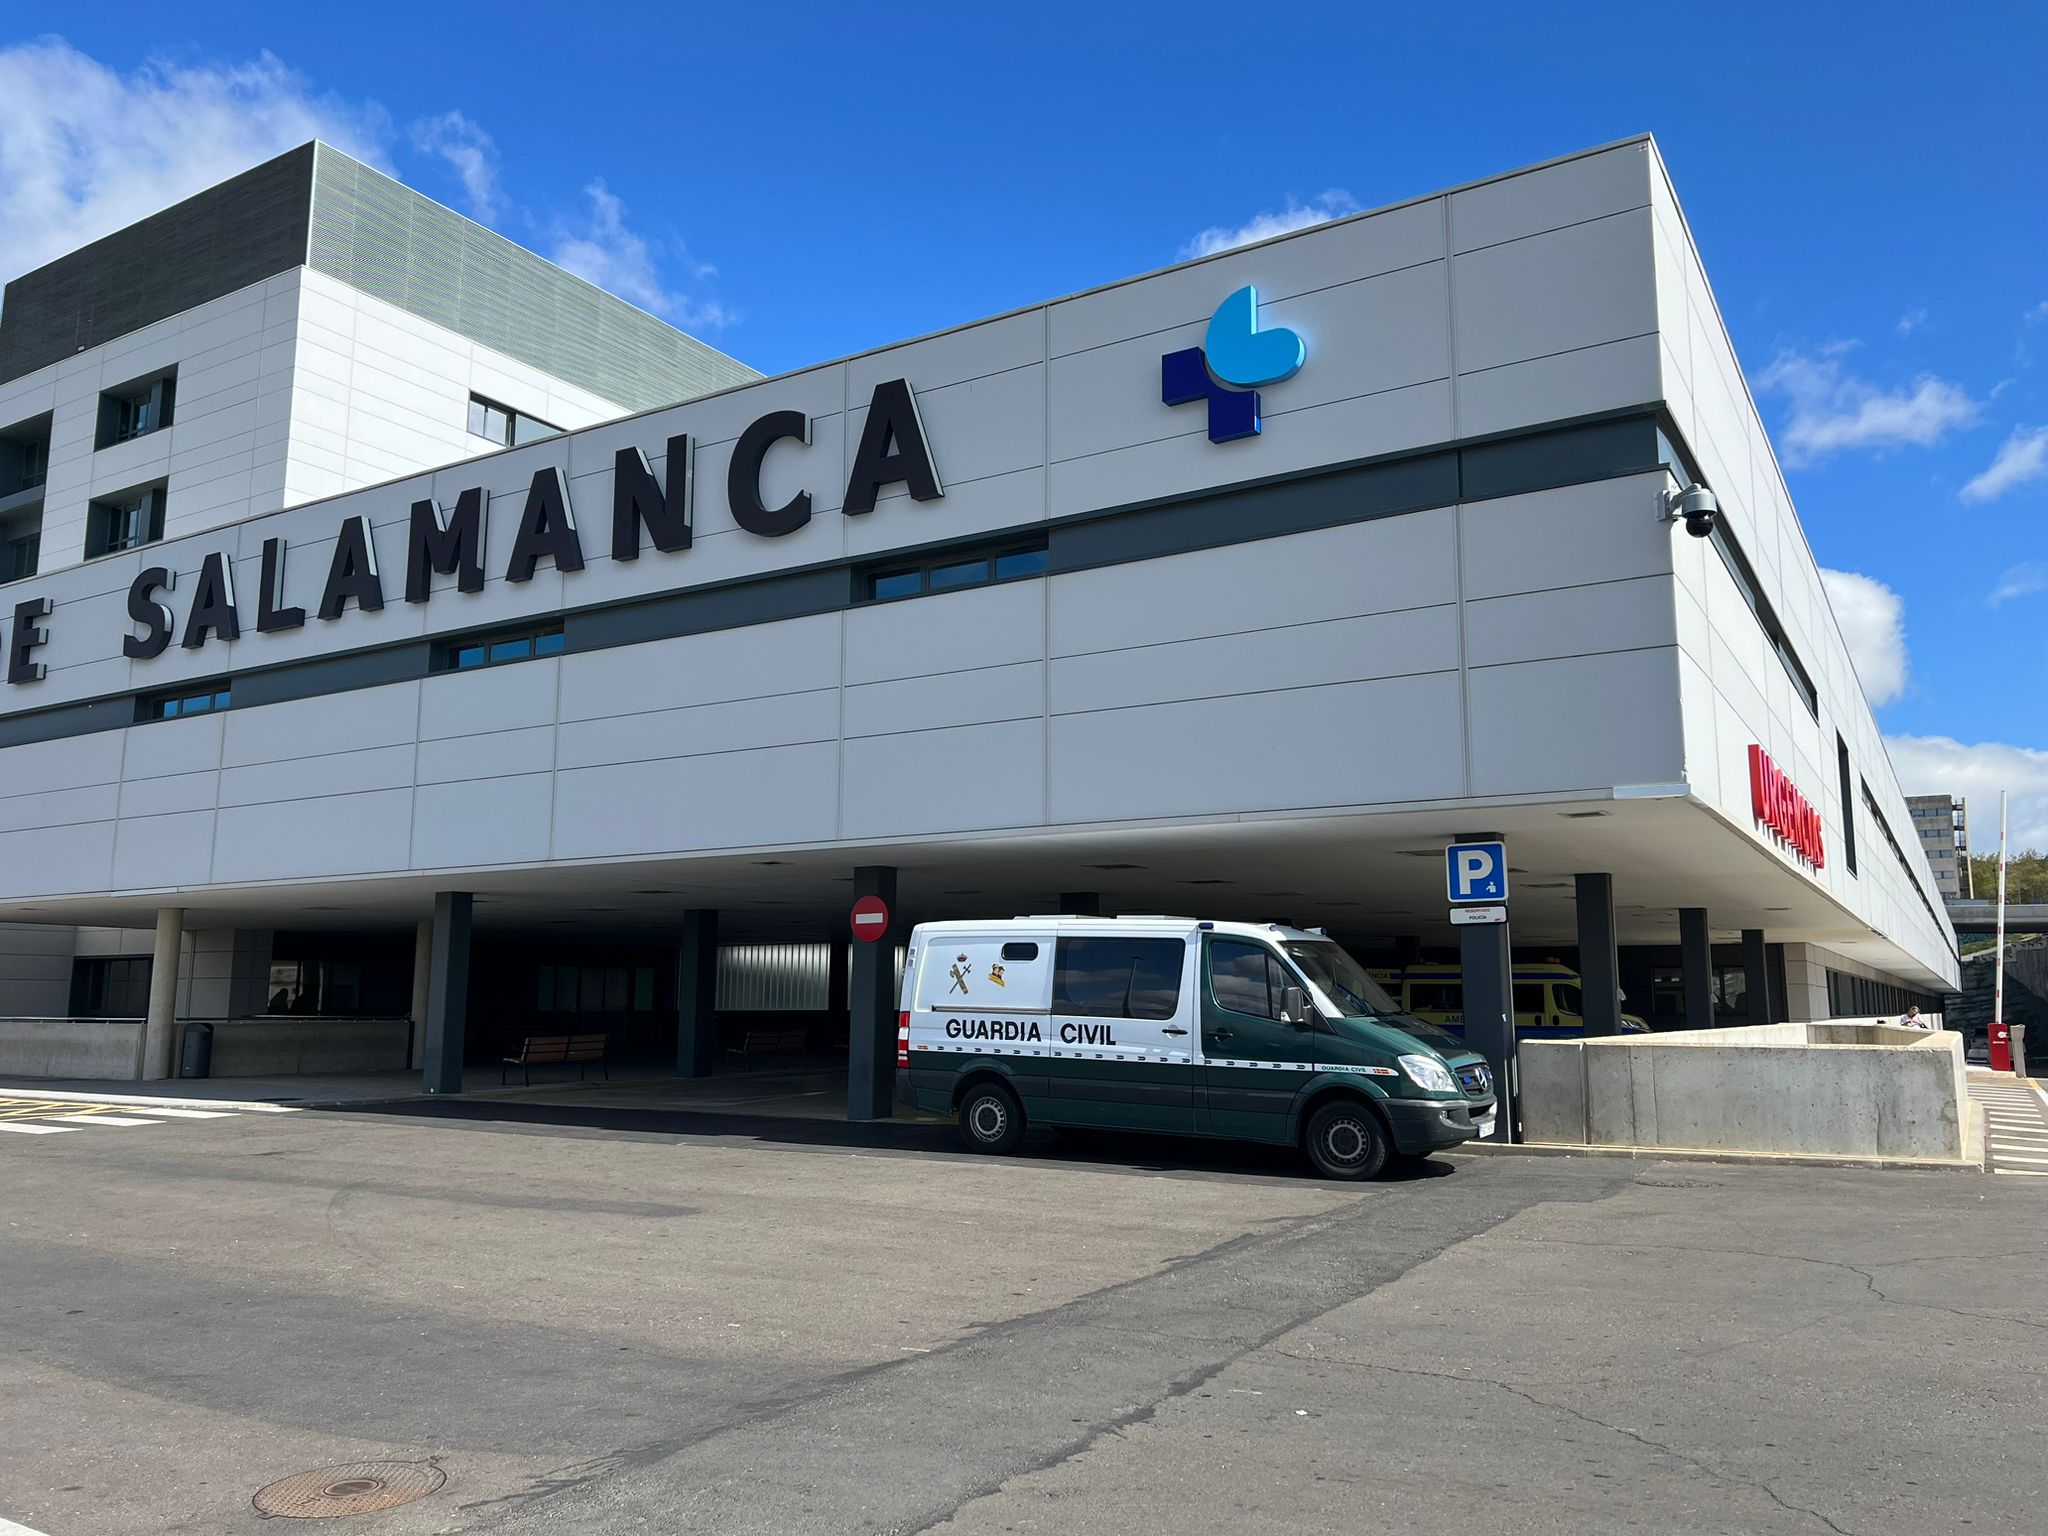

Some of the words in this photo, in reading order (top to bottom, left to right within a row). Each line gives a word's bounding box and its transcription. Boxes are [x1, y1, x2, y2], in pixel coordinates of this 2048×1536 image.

[0, 597, 53, 685] E
[123, 378, 944, 659] SALAMANCA
[1458, 850, 1493, 895] P
[945, 1018, 1042, 1042] GUARDIA
[1060, 1022, 1117, 1046] CIVIL
